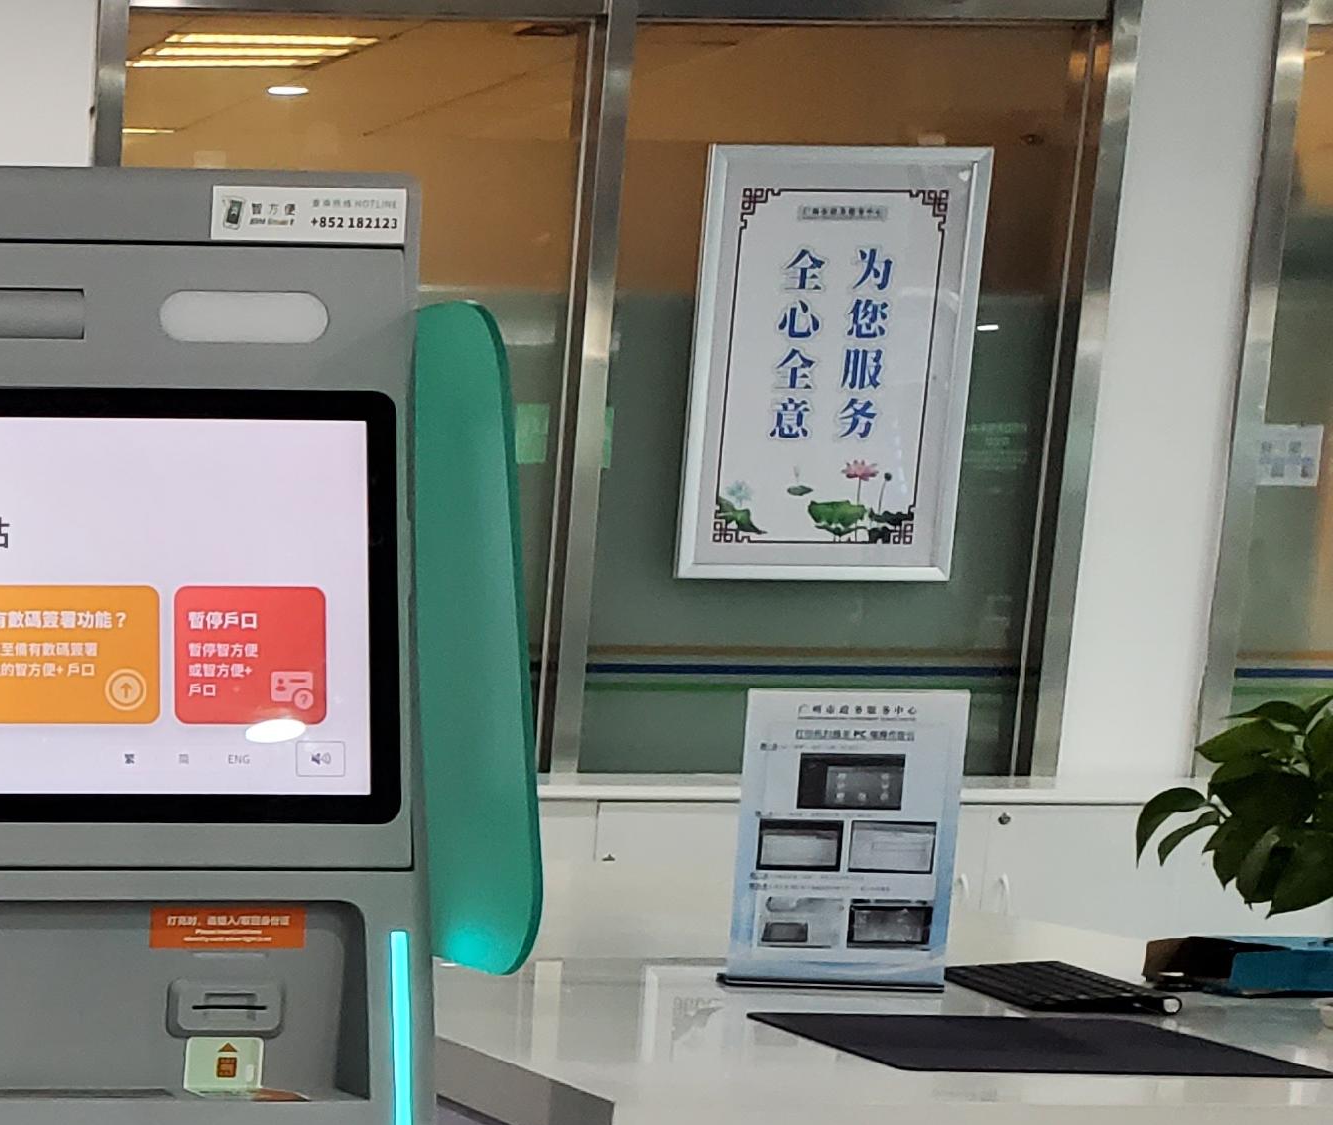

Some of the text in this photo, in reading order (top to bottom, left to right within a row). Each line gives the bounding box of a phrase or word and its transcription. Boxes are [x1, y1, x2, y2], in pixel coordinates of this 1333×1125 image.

[310, 216, 344, 229] +852
[769, 247, 825, 440] 全心全意
[837, 247, 894, 440] 为您服务
[187, 610, 259, 631] 暫停戶口
[187, 642, 259, 658] 暫停智方便
[187, 663, 253, 678] 或智方便+
[187, 683, 217, 697] 戶口
[227, 753, 251, 765] ENG
